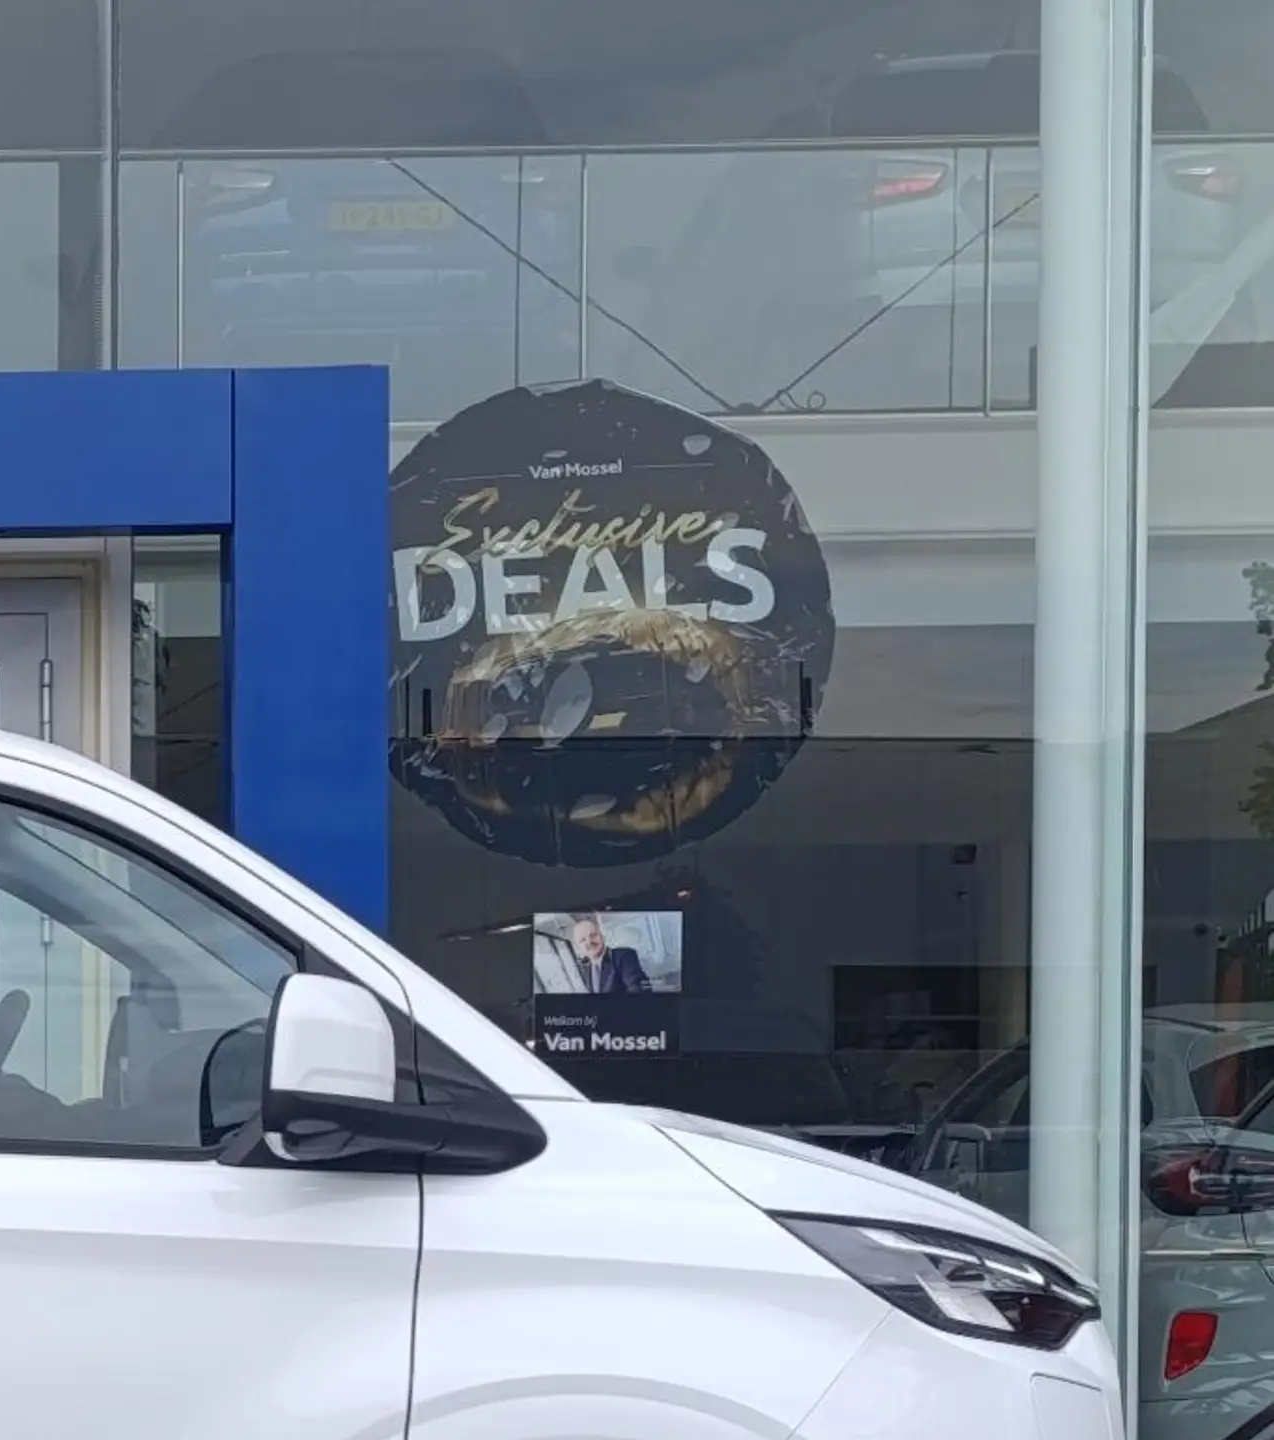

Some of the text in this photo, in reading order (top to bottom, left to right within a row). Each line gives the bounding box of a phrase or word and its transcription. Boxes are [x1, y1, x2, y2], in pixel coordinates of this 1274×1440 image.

[529, 458, 623, 480] Van Mossel
[393, 528, 775, 642] DEALS
[543, 1030, 667, 1051] Van Mossel
